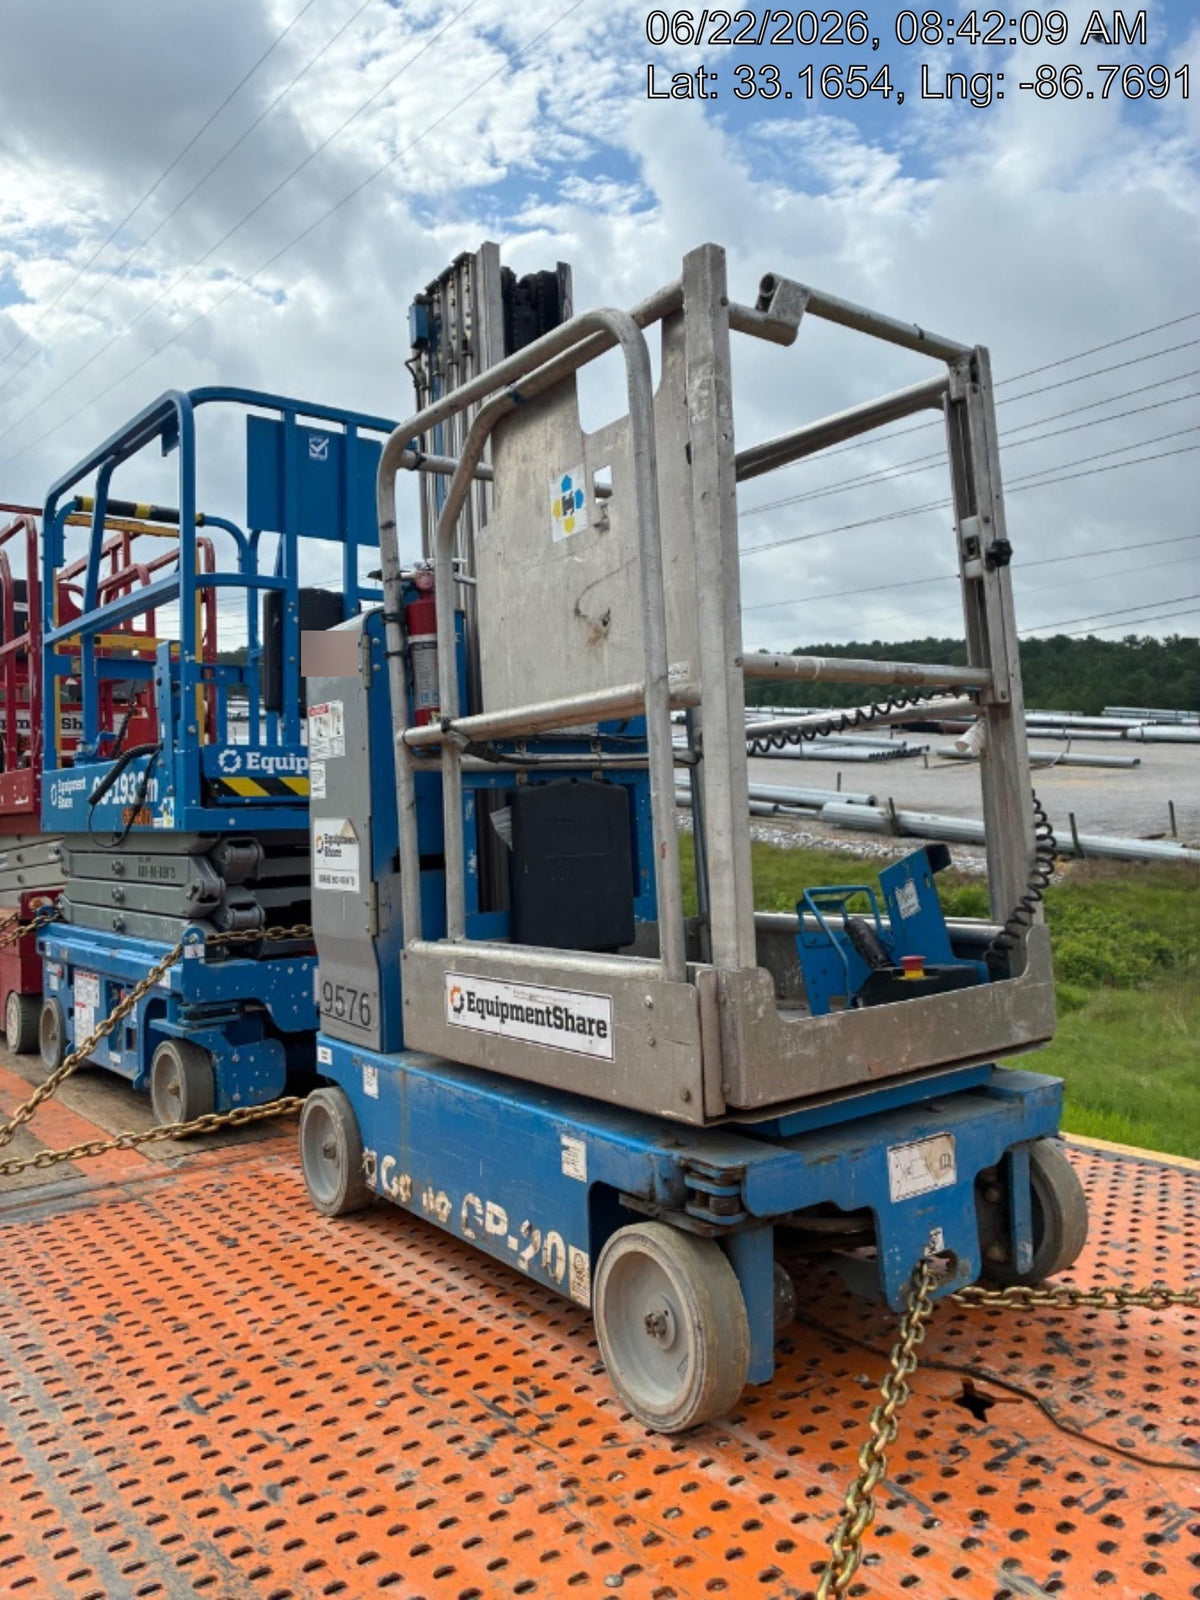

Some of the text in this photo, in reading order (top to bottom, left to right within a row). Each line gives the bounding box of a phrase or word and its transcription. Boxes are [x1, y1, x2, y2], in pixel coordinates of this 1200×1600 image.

[246, 752, 309, 774] Equip
[323, 981, 371, 1026] 9576
[466, 991, 607, 1038] EquipmentShare
